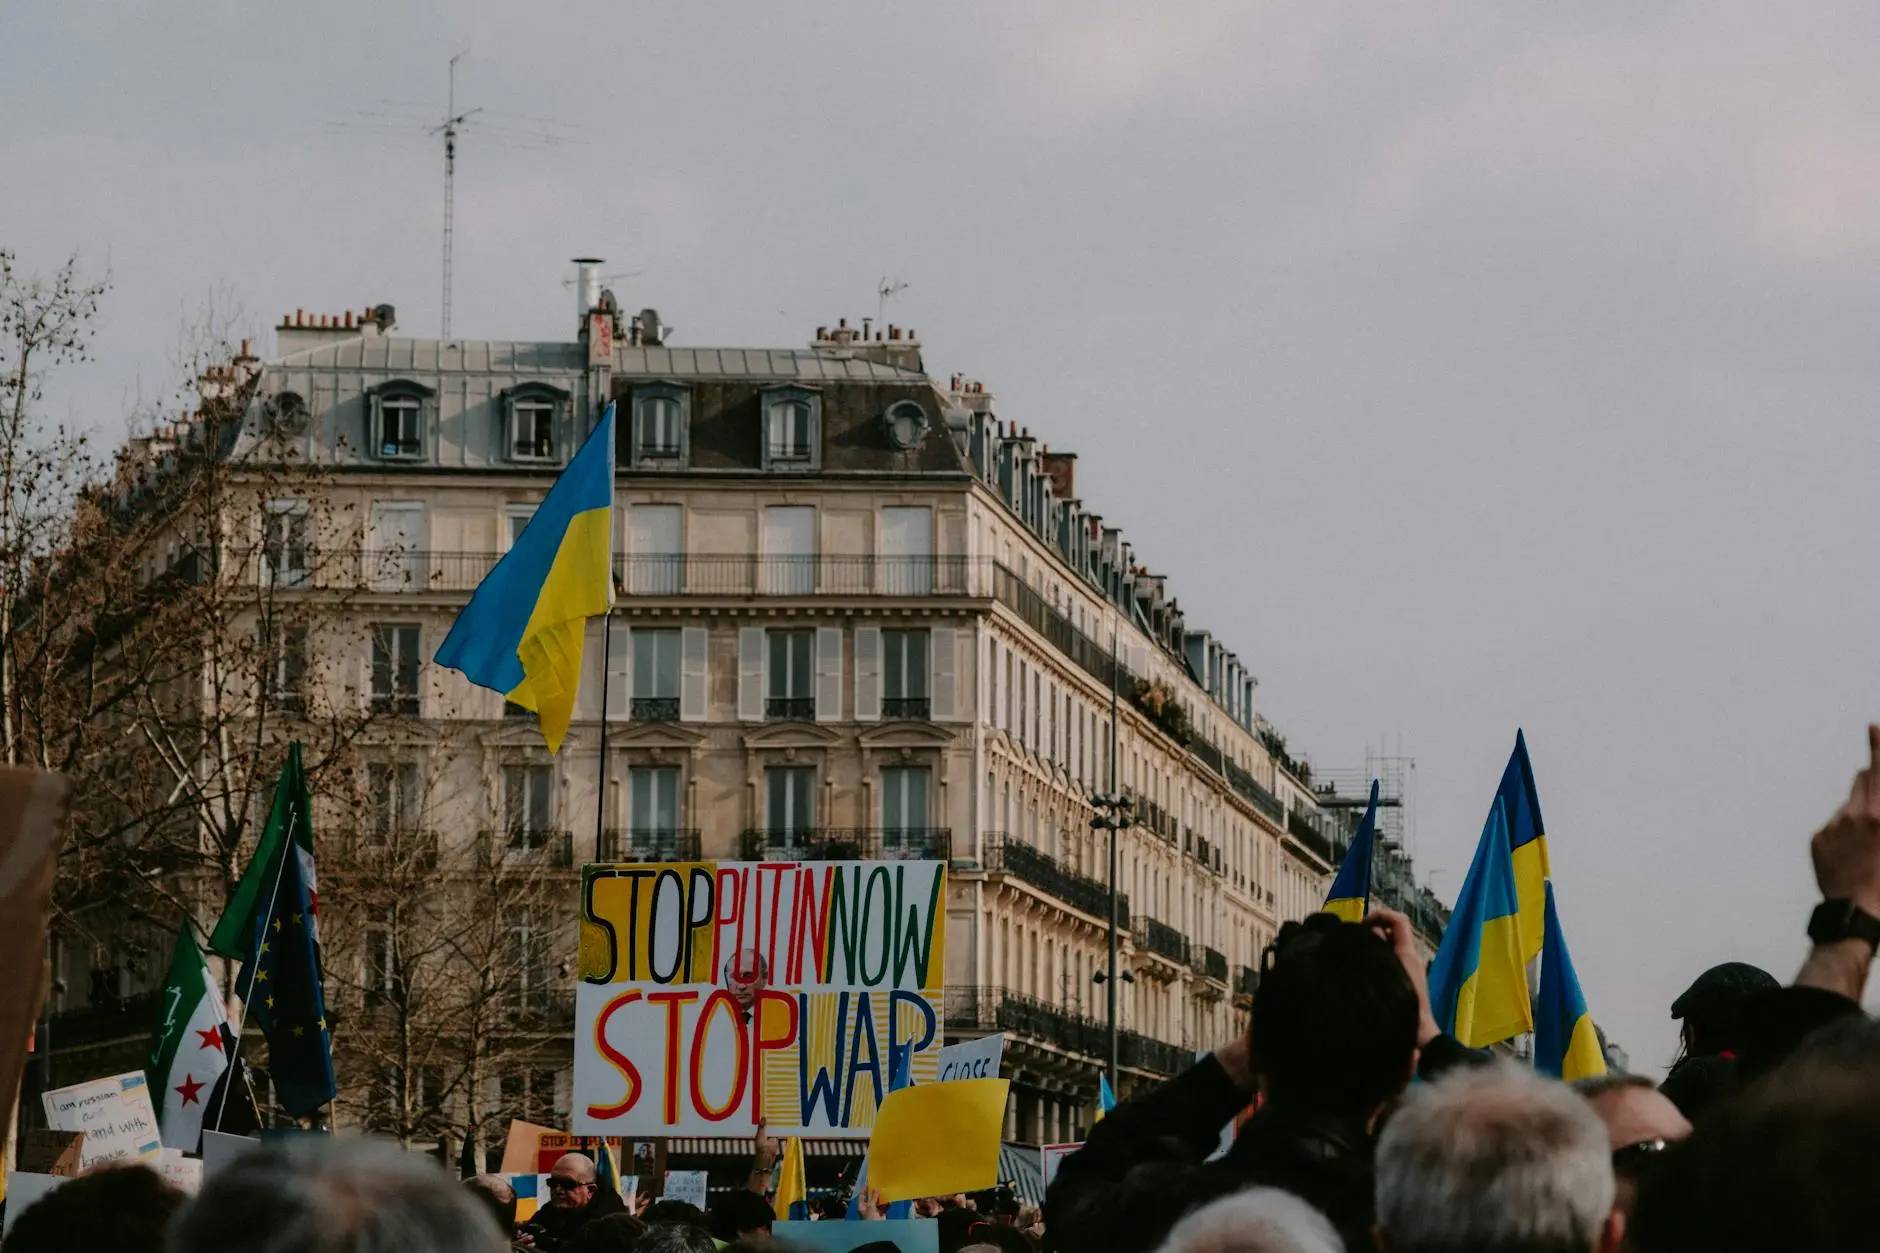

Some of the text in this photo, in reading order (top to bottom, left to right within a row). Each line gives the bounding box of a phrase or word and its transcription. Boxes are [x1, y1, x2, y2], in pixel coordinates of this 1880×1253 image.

[585, 867, 715, 985] STOP
[825, 863, 944, 989] NOW
[586, 987, 799, 1125] STOP
[59, 1101, 77, 1113] am
[541, 1135, 568, 1147] STOP
